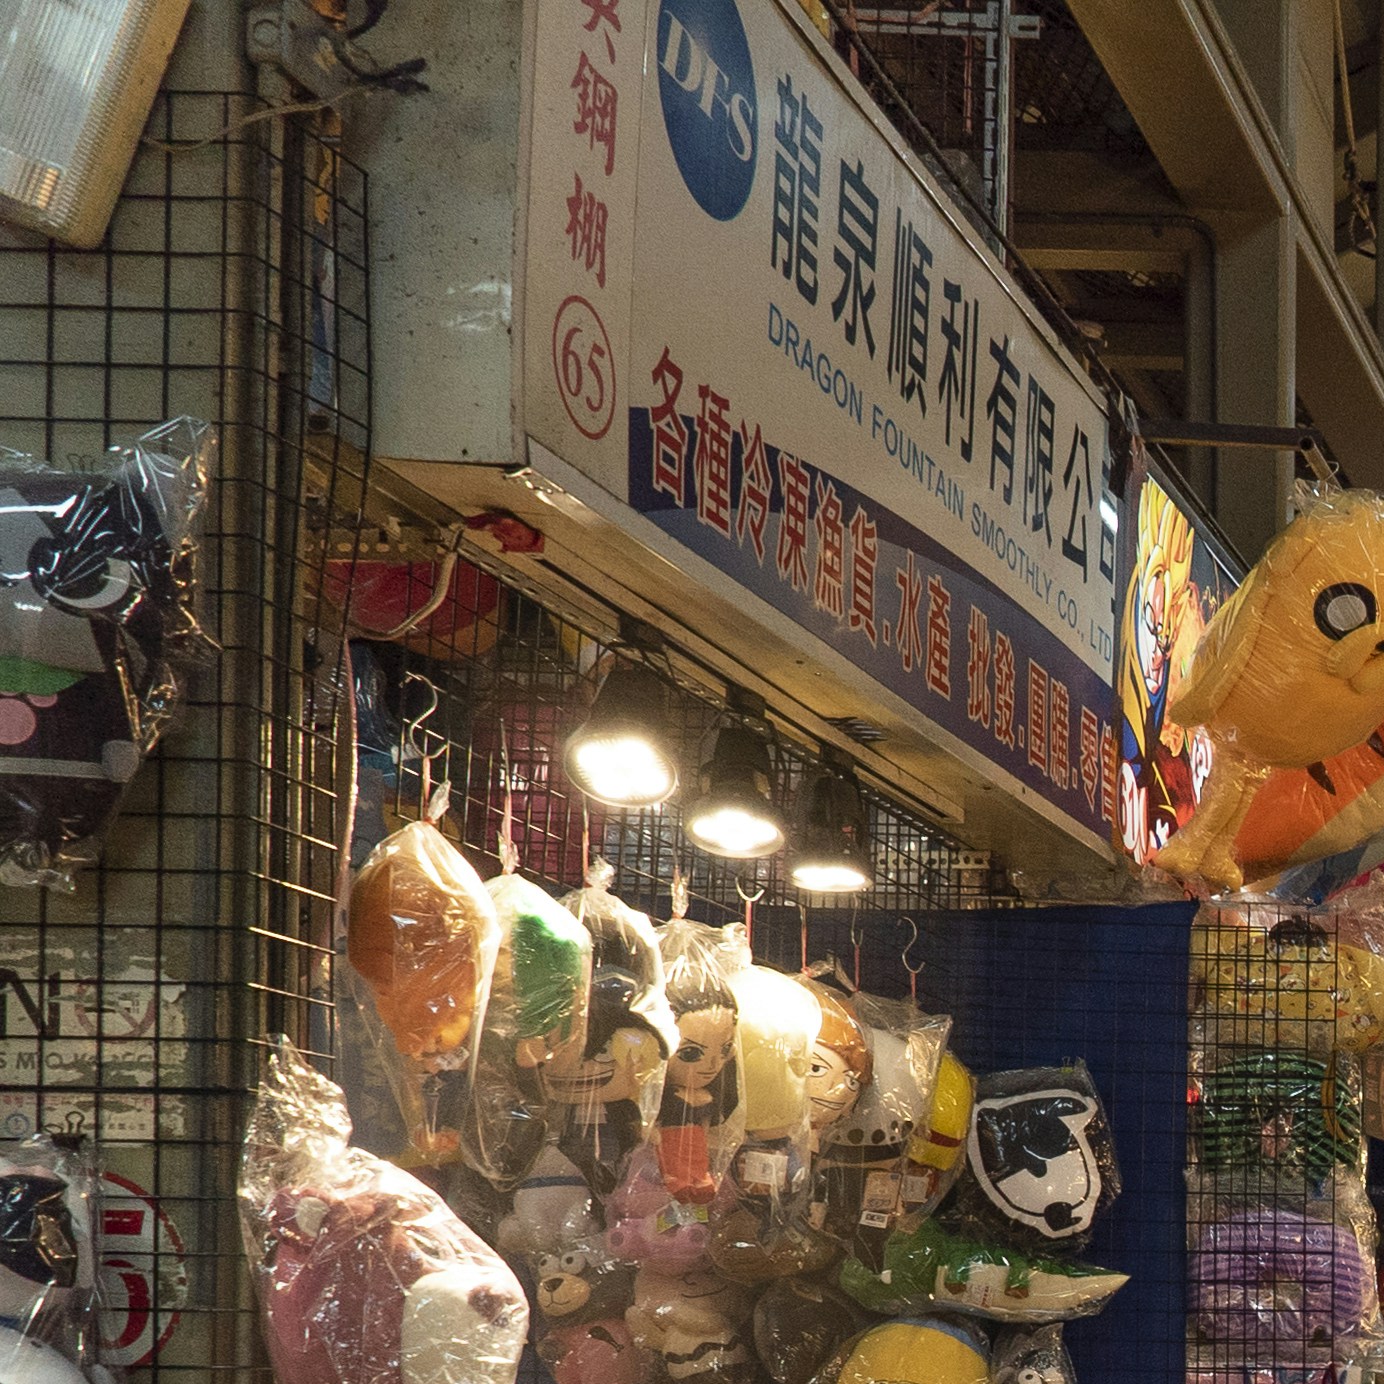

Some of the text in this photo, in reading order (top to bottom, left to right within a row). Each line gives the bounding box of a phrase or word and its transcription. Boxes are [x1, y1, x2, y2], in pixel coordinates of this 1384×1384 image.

[660, 10, 753, 161] DFS
[561, 328, 606, 412] 65
[769, 302, 862, 425] DRAGON
[872, 403, 965, 521] FOUNTAIN
[971, 502, 1053, 604] SMOOTHLY
